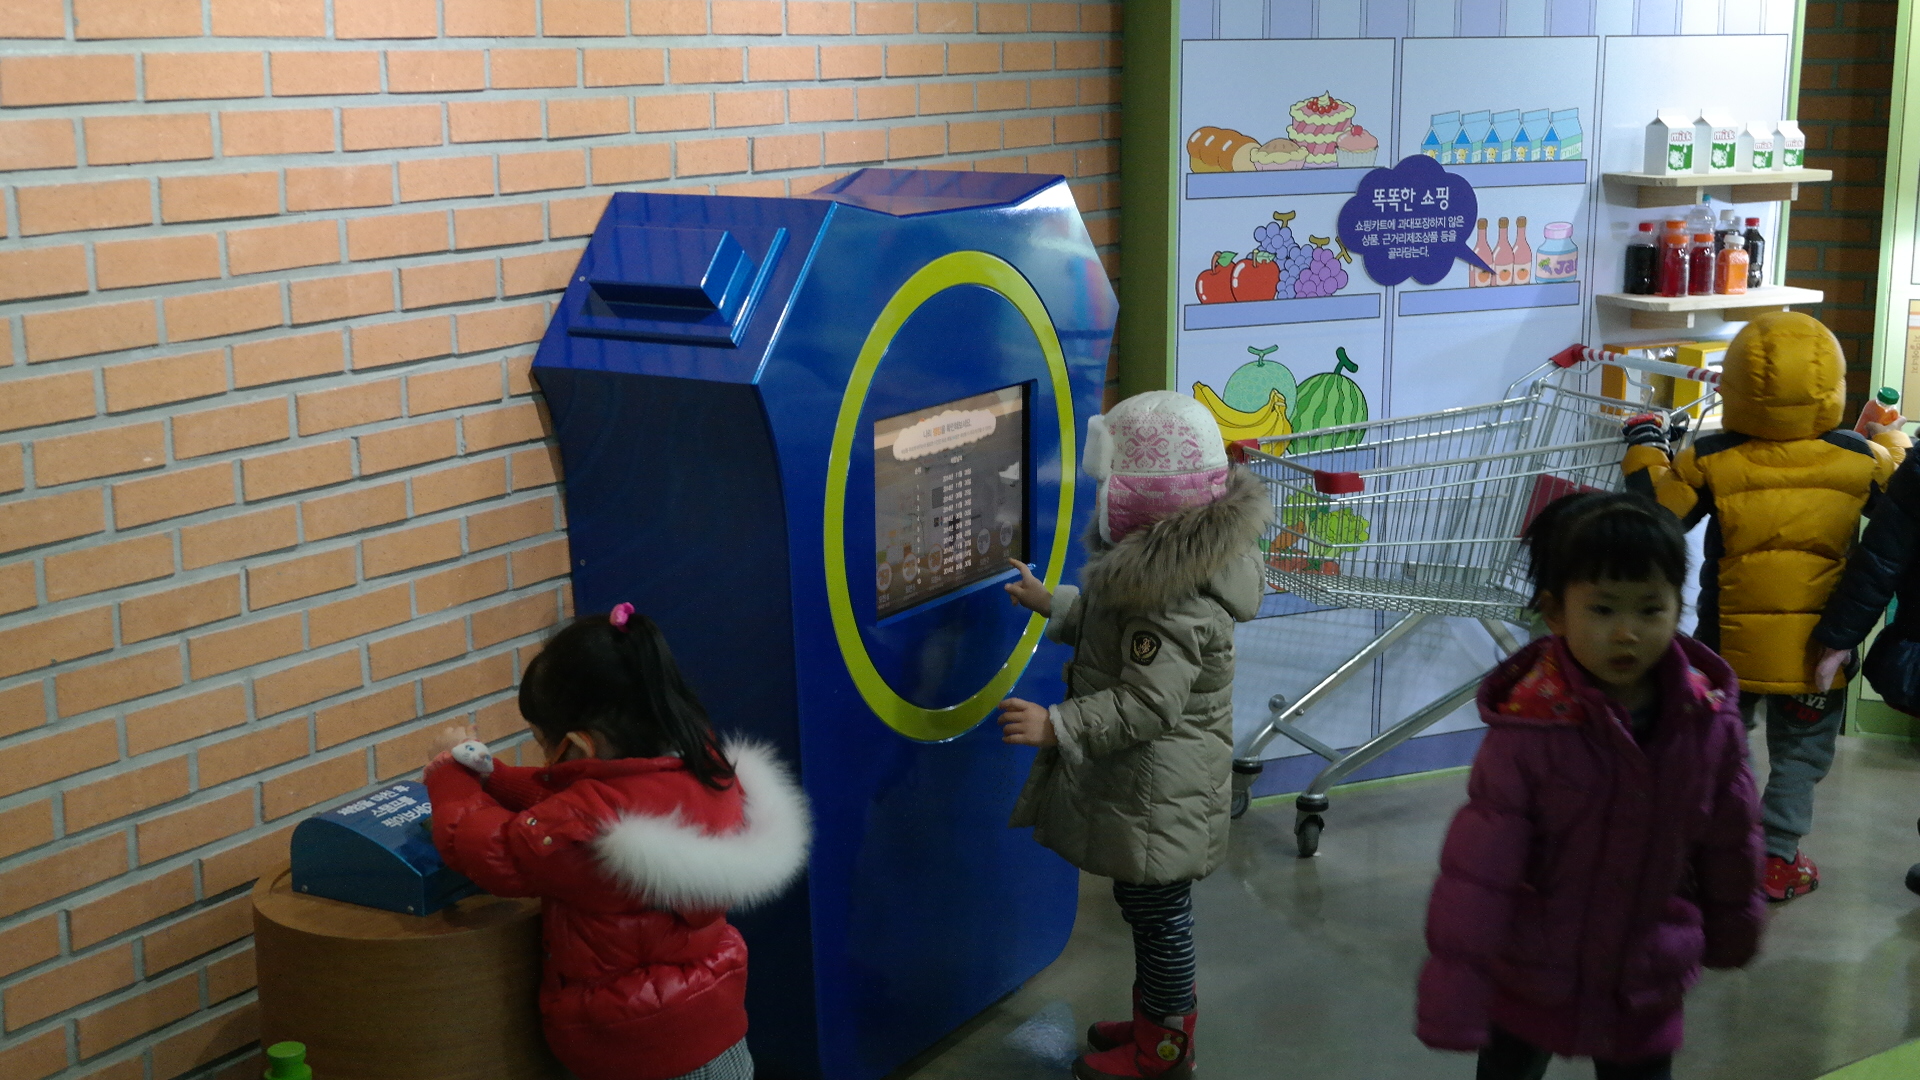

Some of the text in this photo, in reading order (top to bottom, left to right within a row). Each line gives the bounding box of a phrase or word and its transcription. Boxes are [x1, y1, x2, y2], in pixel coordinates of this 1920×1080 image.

[1671, 130, 1692, 142] milk
[1714, 129, 1735, 141] milk
[1754, 141, 1773, 150] milk
[1785, 139, 1804, 148] milk
[1372, 186, 1449, 213] 똑똑한 쇼핑
[1354, 215, 1465, 232] 쇼핑카트에 과대포장하지 않은
[1382, 231, 1439, 245] 근거리제조상품
[1440, 230, 1457, 243] 등을
[1388, 245, 1430, 260] 골라담는다.
